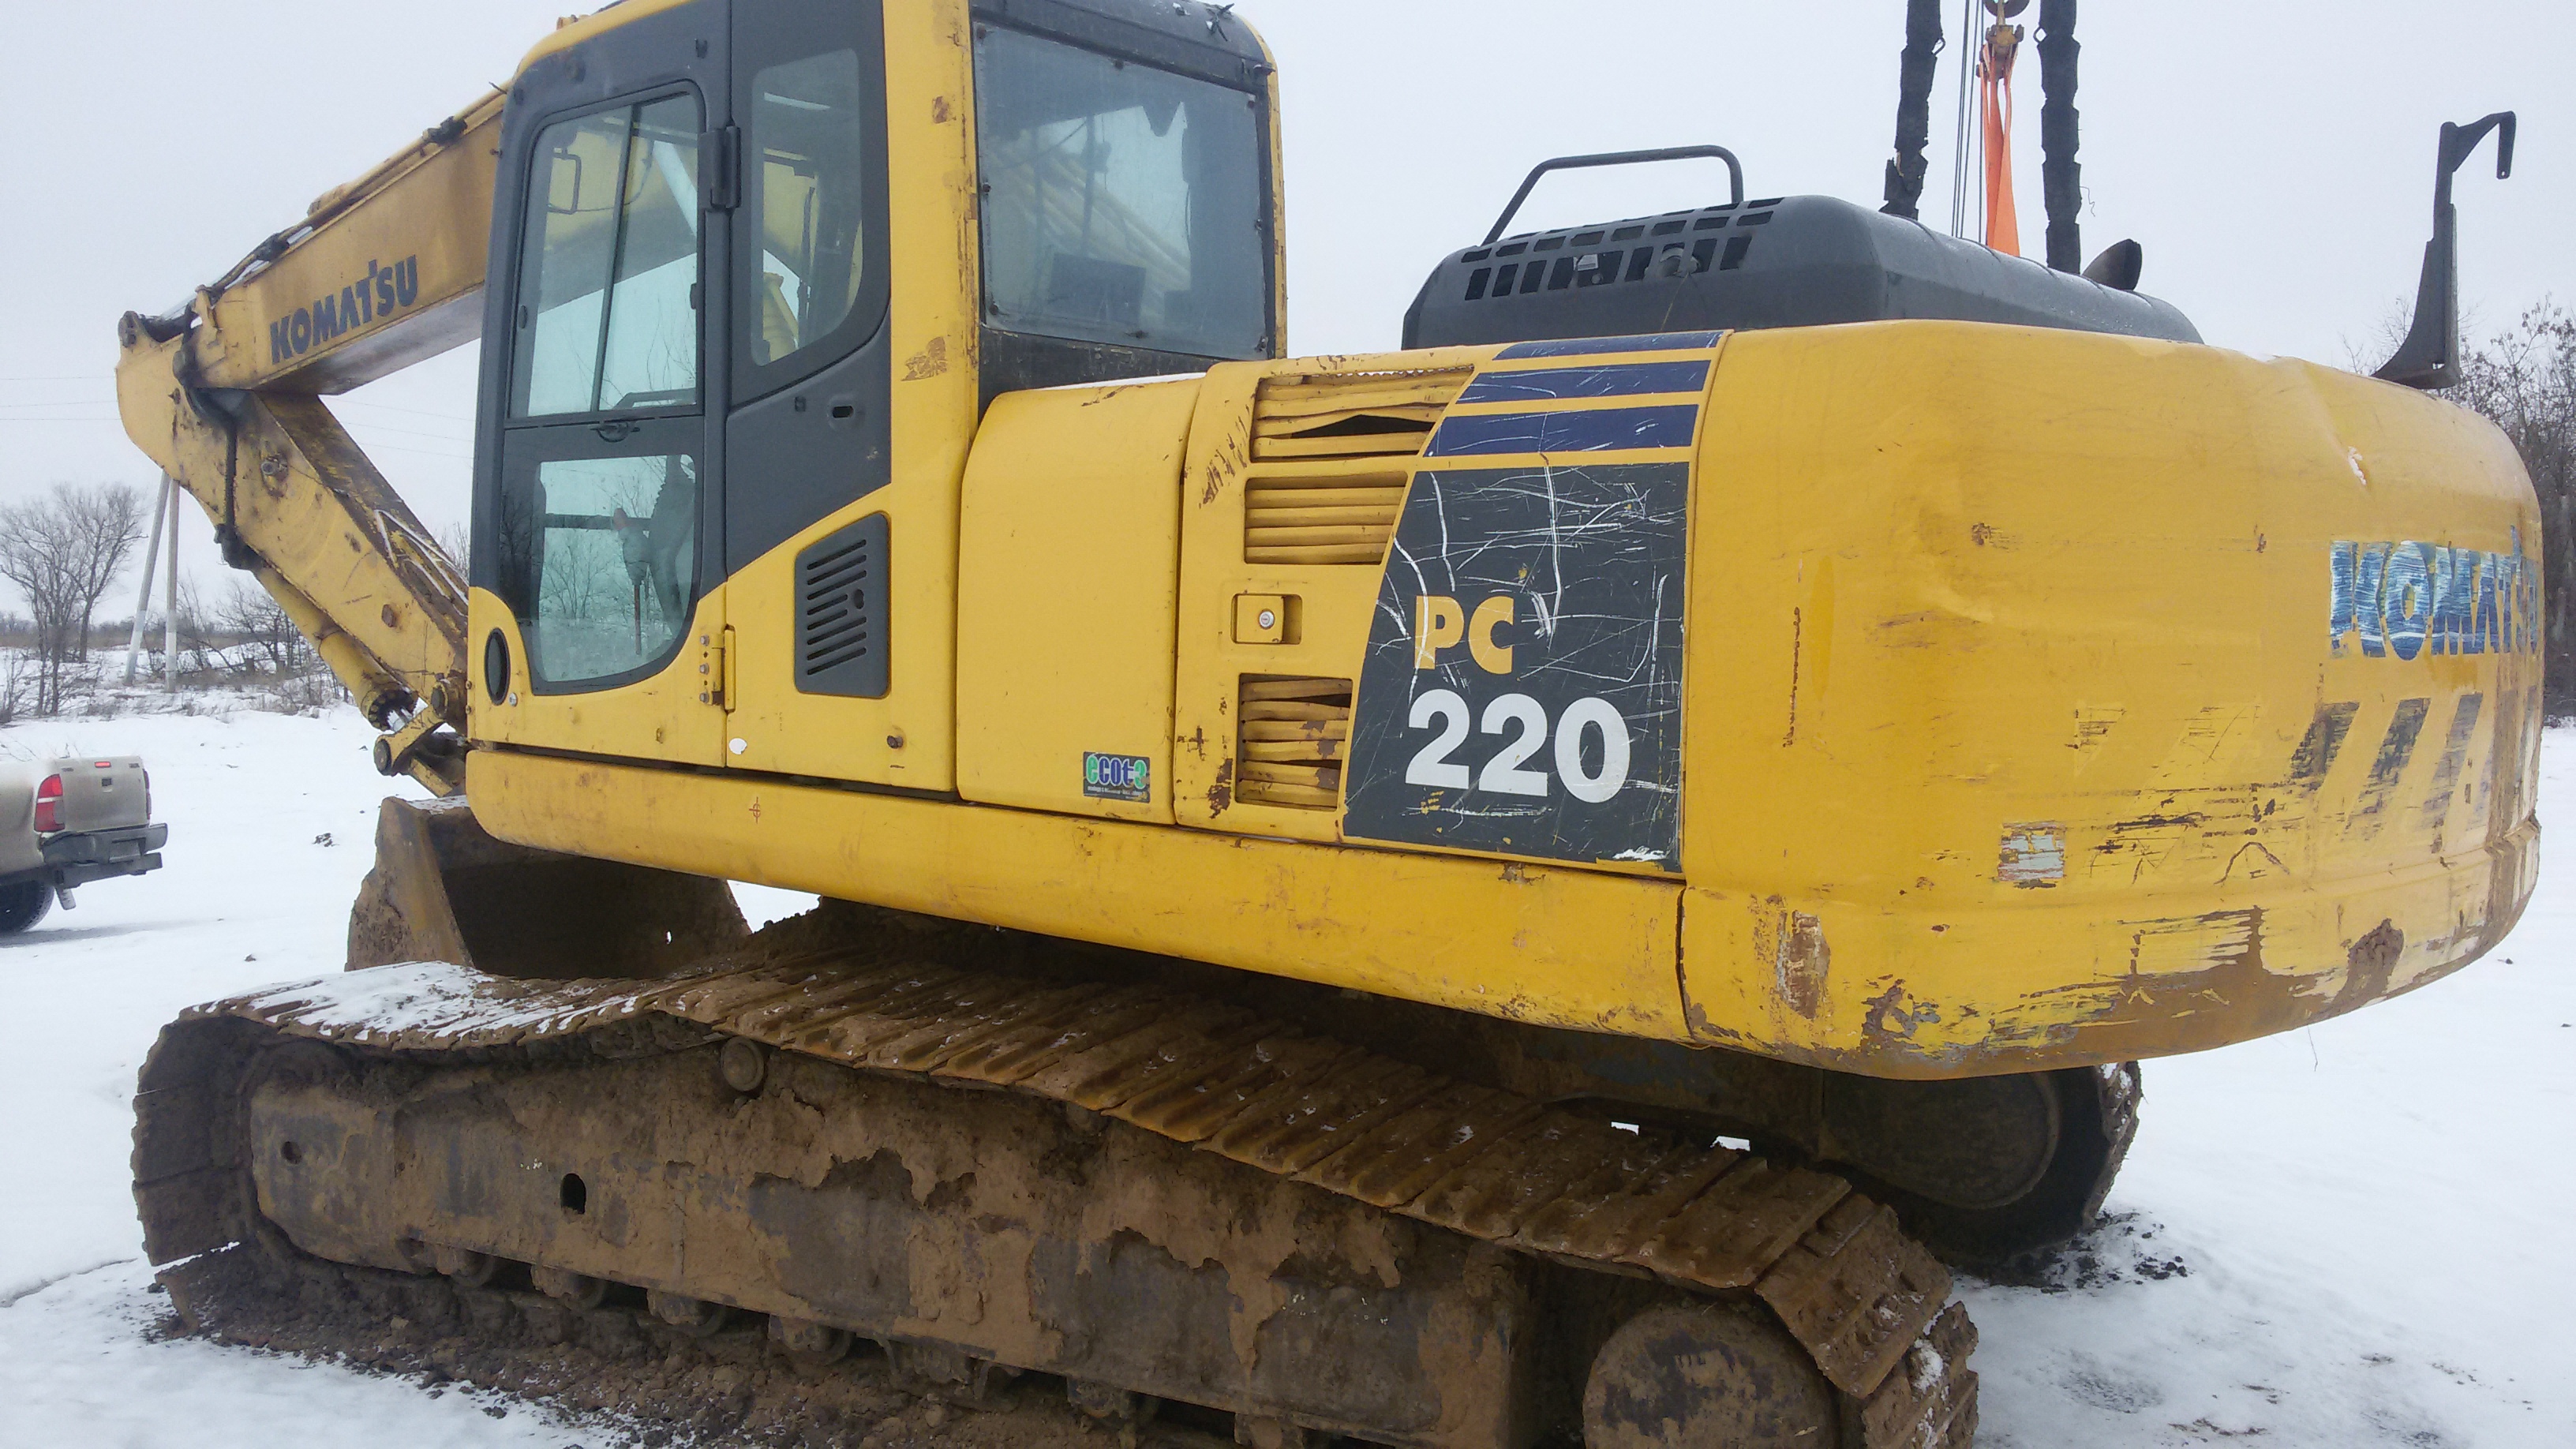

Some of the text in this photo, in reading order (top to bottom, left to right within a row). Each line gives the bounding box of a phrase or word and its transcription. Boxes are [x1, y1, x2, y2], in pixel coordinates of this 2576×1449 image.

[270, 254, 417, 365] KOMATSU
[1414, 595, 1515, 675] PC
[1405, 688, 1631, 803] 220
